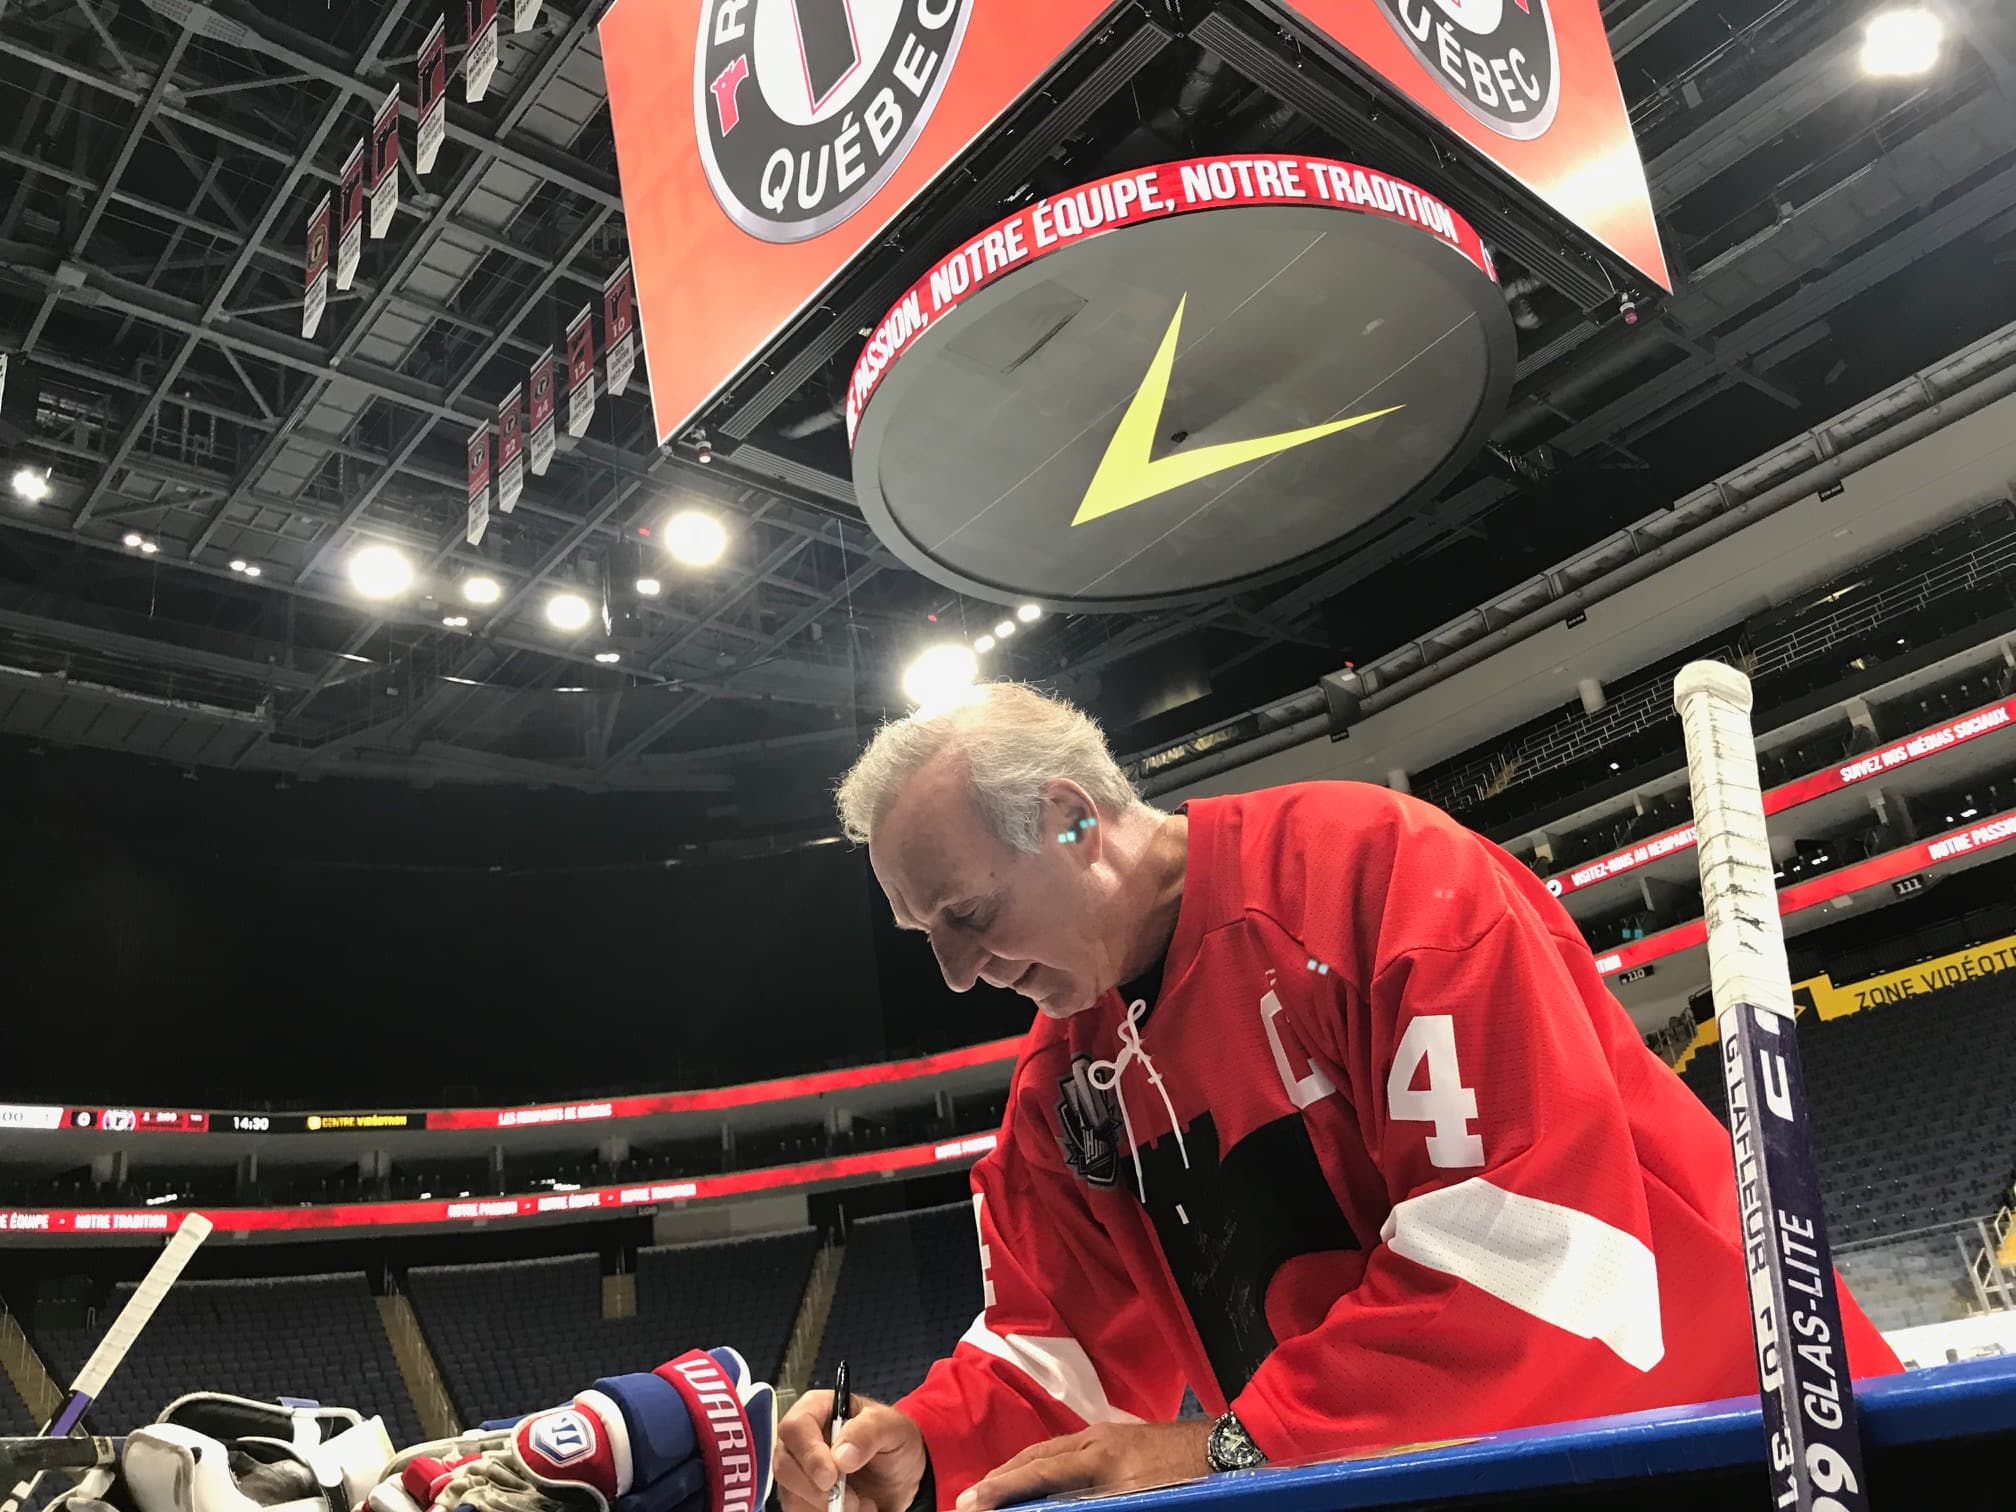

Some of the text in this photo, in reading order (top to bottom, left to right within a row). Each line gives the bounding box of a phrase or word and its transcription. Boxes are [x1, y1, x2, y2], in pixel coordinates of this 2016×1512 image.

[759, 0, 957, 214] QUÉBEC
[855, 160, 1459, 410] PASSION, NOTRE ÉQUIPE, NOTRE TRADITION
[1840, 707, 2010, 782] SUIVEZ NOS MÉDIAS SOCIAUX
[1928, 832, 1972, 860] NOTRE
[1896, 878, 1922, 894] 111
[1854, 947, 2016, 1009] ZONE VIDÉOT
[233, 1115, 269, 1131] 14:30
[1387, 1014, 1485, 1168] 4
[10, 1213, 50, 1230] ÉQUIPE
[75, 1214, 112, 1229] NOTRE
[113, 1214, 168, 1229] TRADITION
[1779, 1209, 1844, 1430] GLAS-LITE
